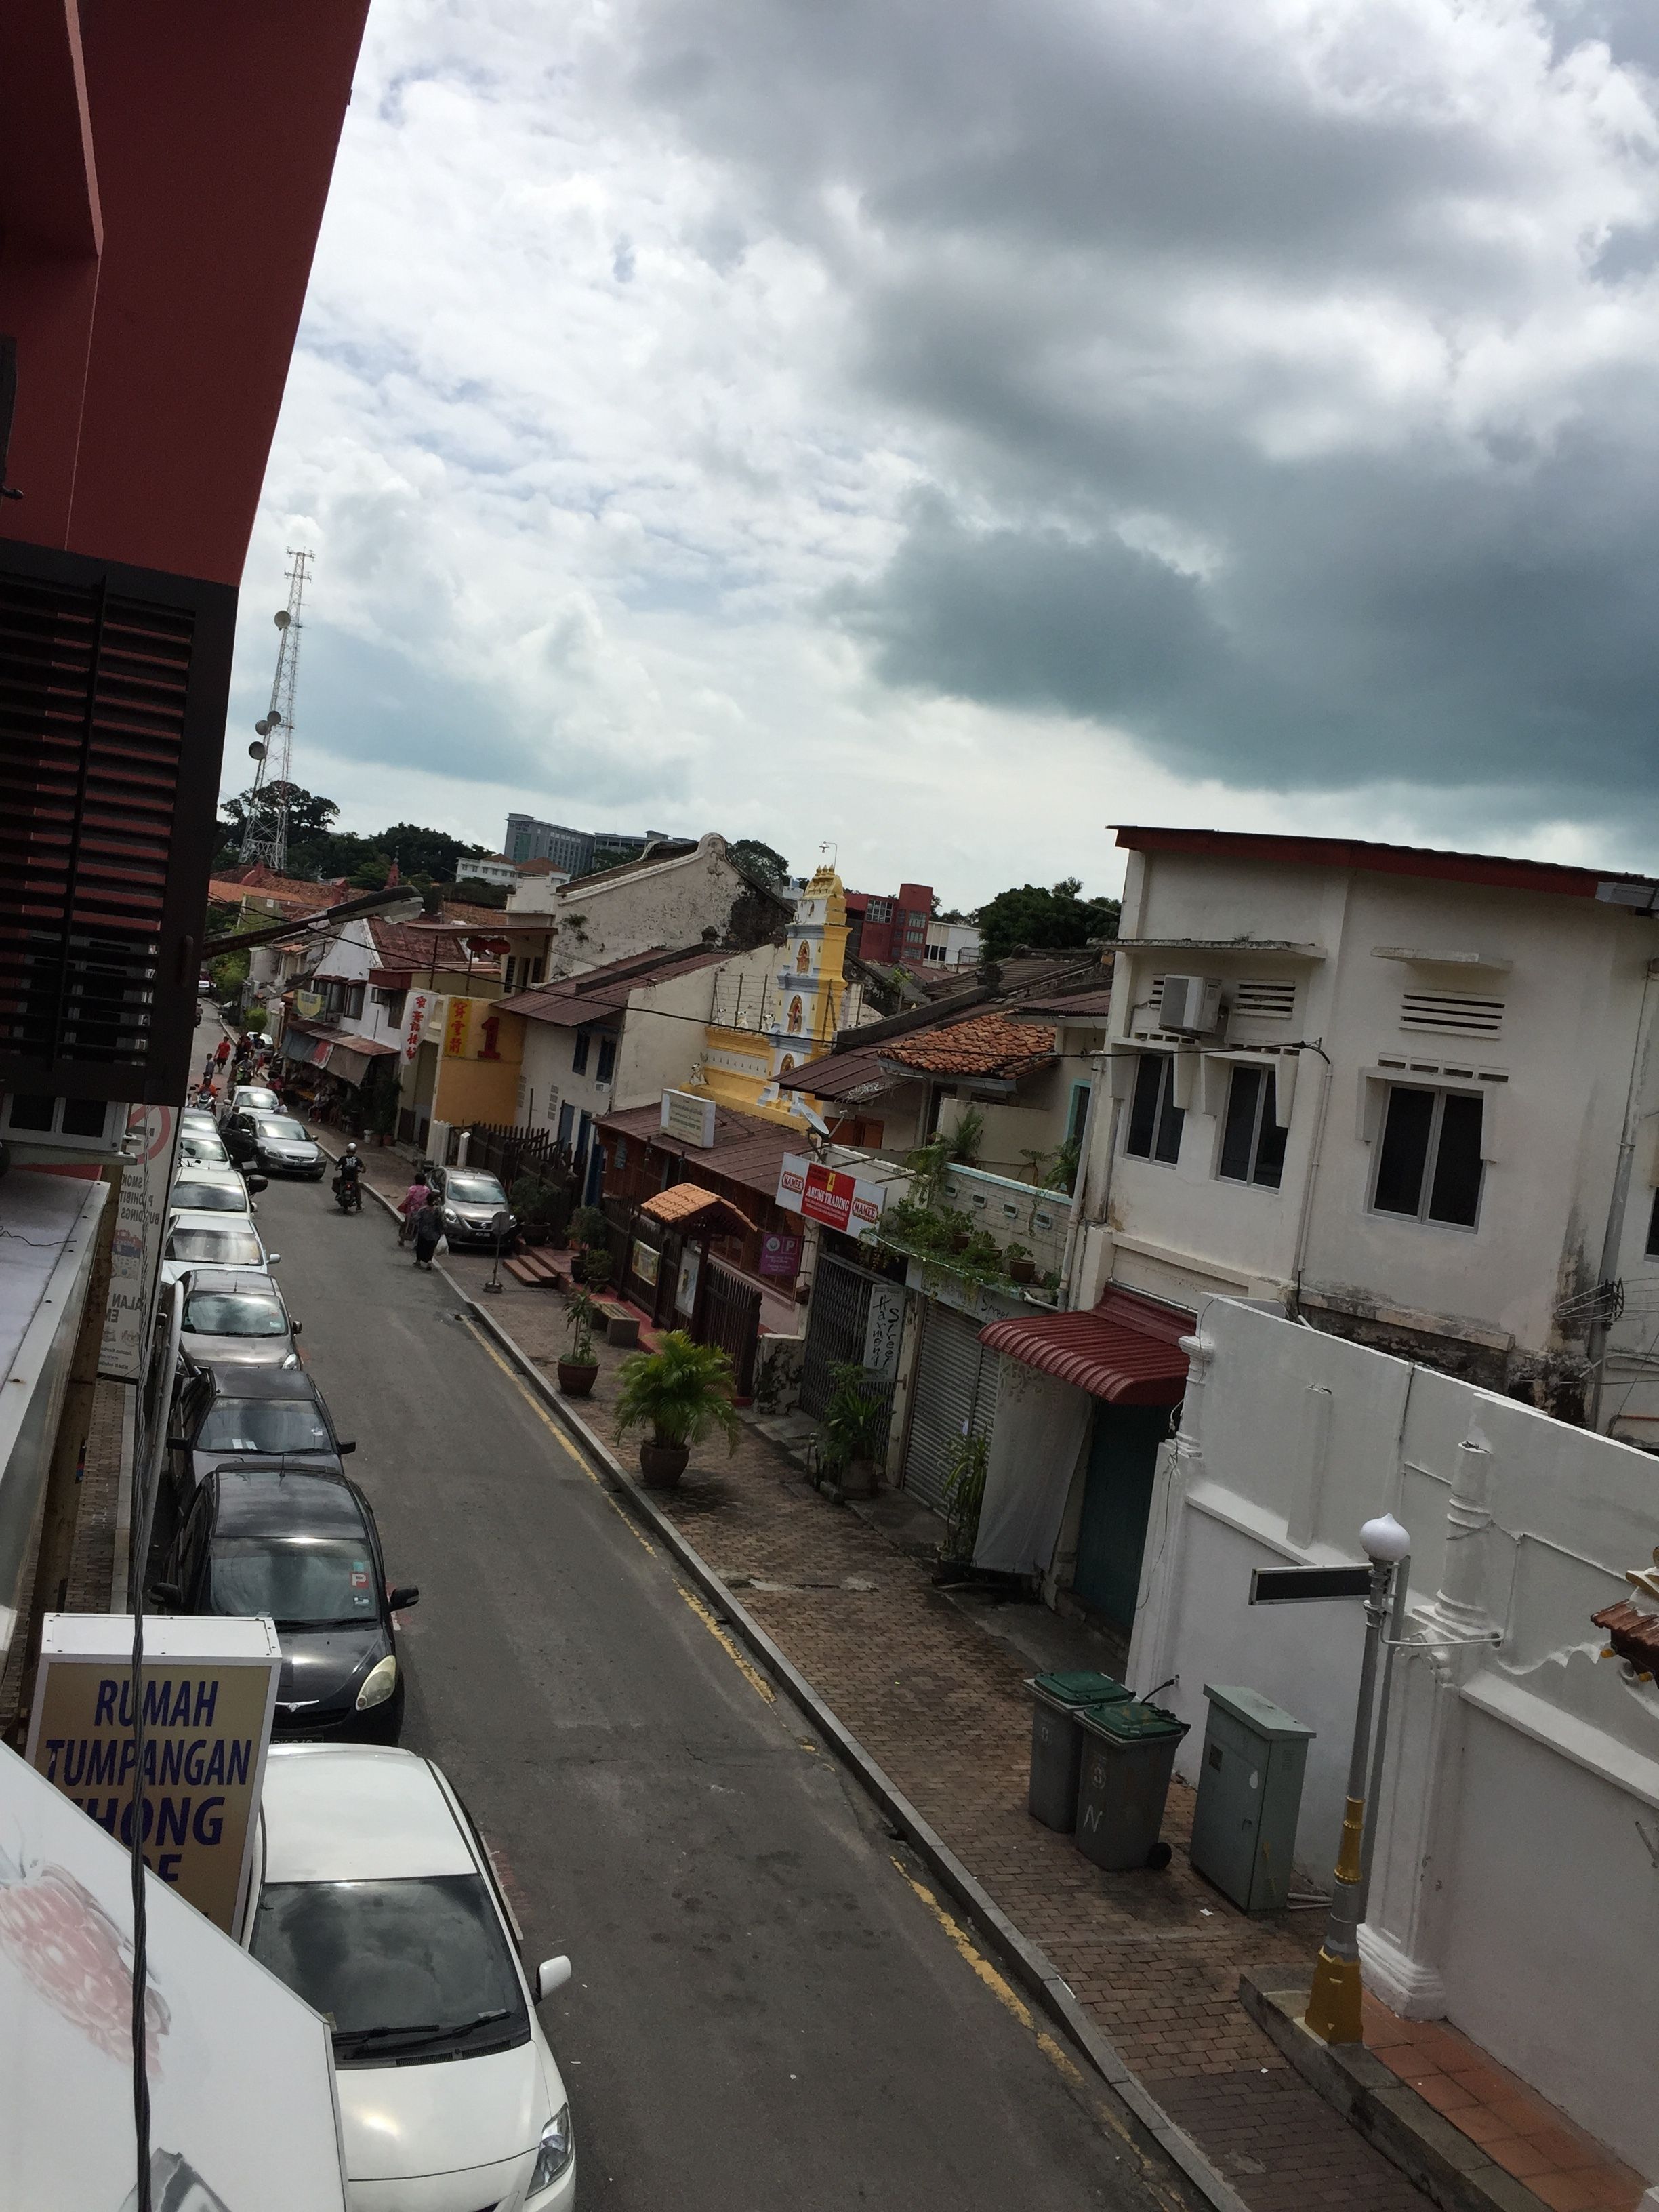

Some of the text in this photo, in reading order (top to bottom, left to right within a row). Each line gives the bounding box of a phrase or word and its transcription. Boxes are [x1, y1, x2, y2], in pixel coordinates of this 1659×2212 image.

[478, 1016, 501, 1059] 1
[783, 1175, 802, 1191] MAMEE
[825, 1192, 850, 1212] TRADING
[853, 1201, 877, 1220] MAMEE
[352, 1573, 367, 1587] P
[94, 1679, 220, 1727] RUMAH
[46, 1739, 252, 1786] TUMPANGAN
